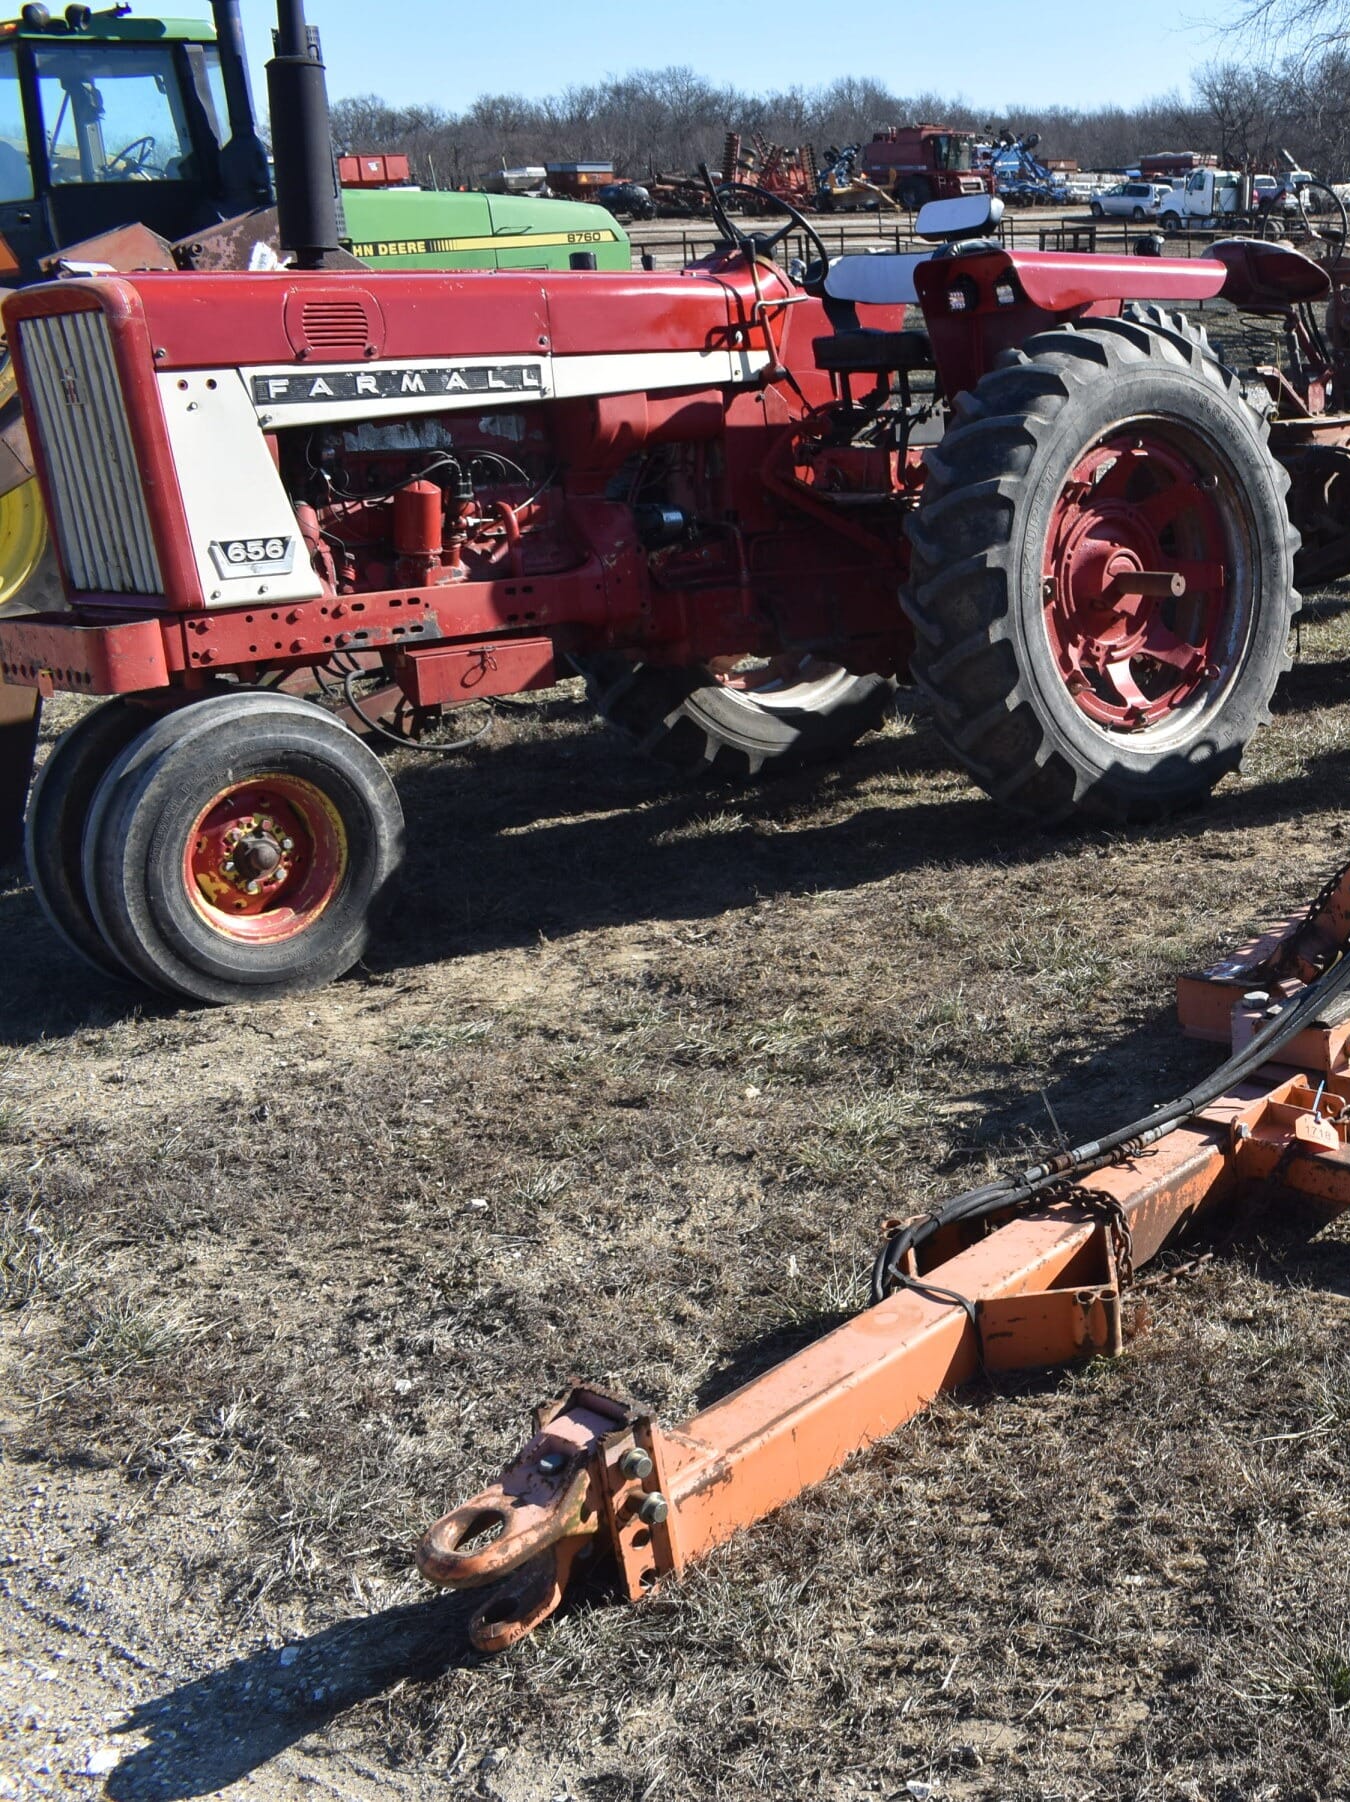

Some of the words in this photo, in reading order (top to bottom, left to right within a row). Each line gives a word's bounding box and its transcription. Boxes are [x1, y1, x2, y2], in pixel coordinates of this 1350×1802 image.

[567, 232, 601, 243] 8760
[377, 241, 426, 255] DEERE
[268, 368, 539, 398] FARMALL
[227, 539, 284, 562] 656
